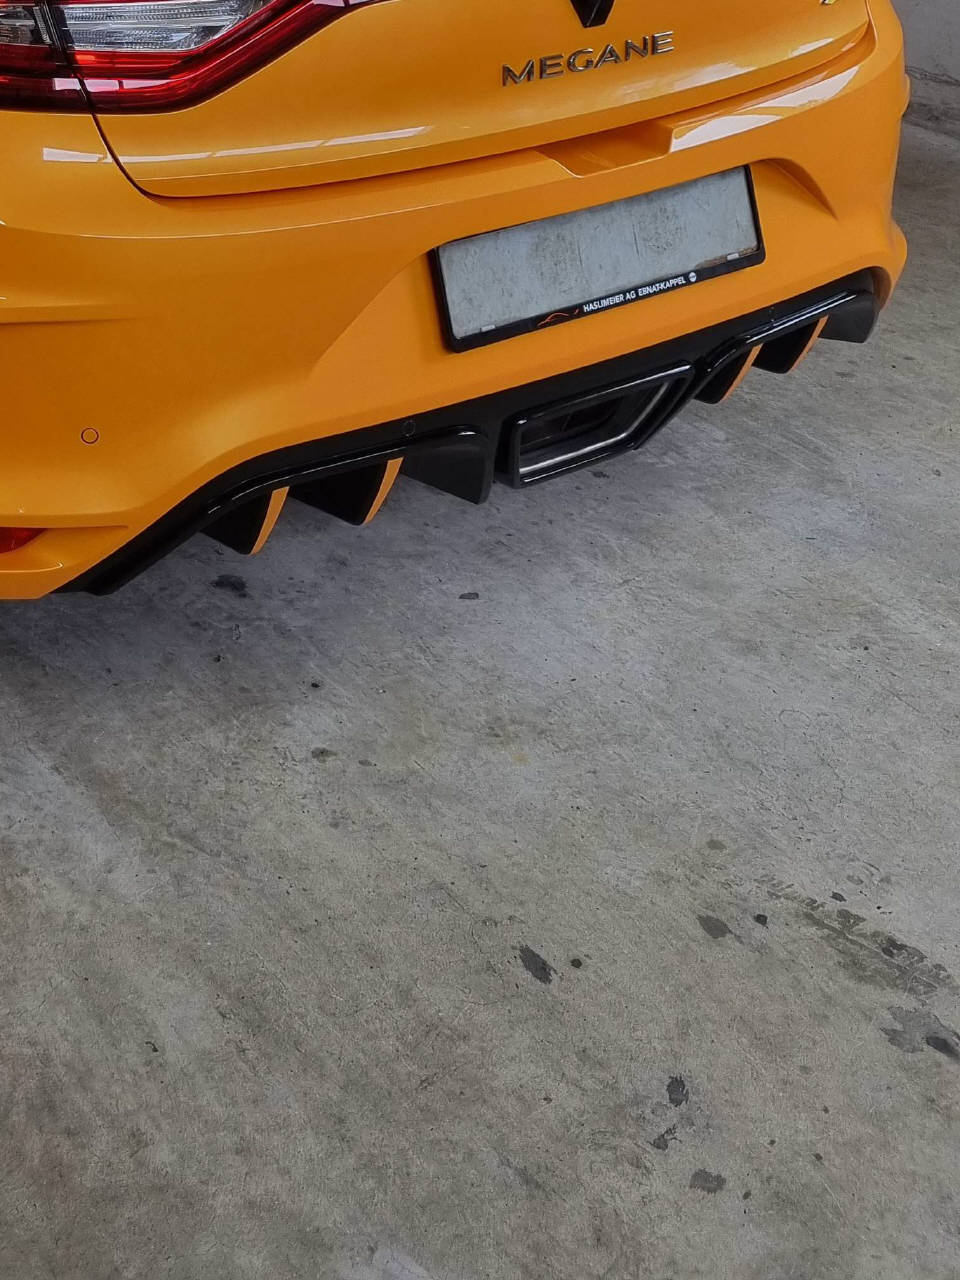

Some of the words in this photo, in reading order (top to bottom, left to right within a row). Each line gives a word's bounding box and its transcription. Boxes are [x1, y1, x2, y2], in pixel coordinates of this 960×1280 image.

[502, 30, 675, 87] MEGANE
[625, 290, 637, 301] AG
[638, 276, 687, 297] EBNAT-KAPPEL
